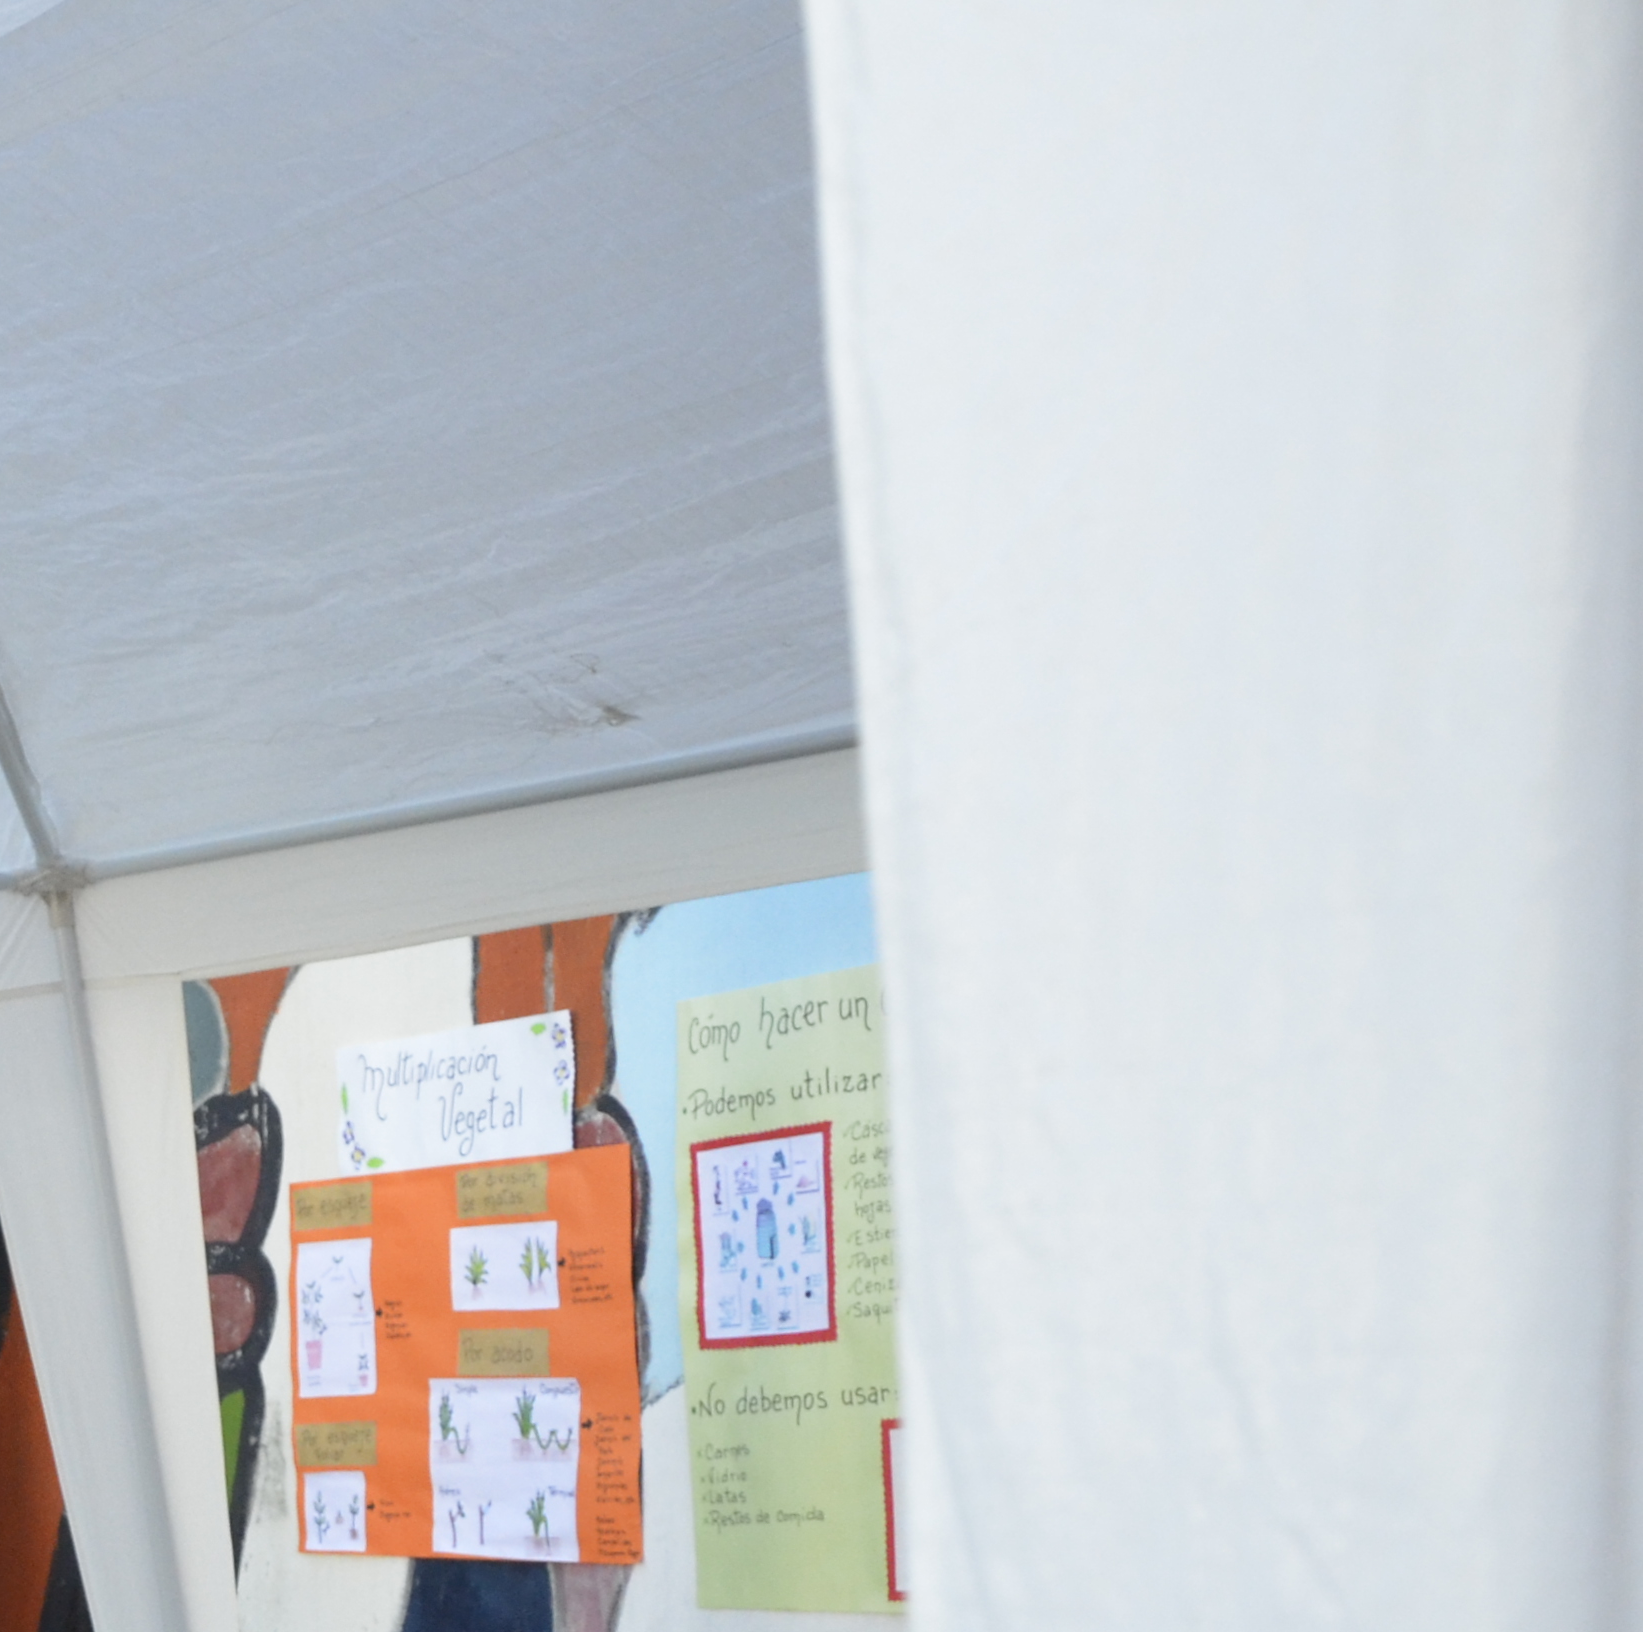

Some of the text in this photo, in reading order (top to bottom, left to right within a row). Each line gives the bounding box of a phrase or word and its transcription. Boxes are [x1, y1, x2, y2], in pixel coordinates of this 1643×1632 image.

[688, 1013, 741, 1062] Cómo
[759, 996, 828, 1050] hacer
[839, 996, 872, 1031] un
[438, 1081, 523, 1157] Vegetal
[688, 1086, 776, 1121] Podemos
[698, 1382, 726, 1417] No
[735, 1385, 828, 1426] debemos
